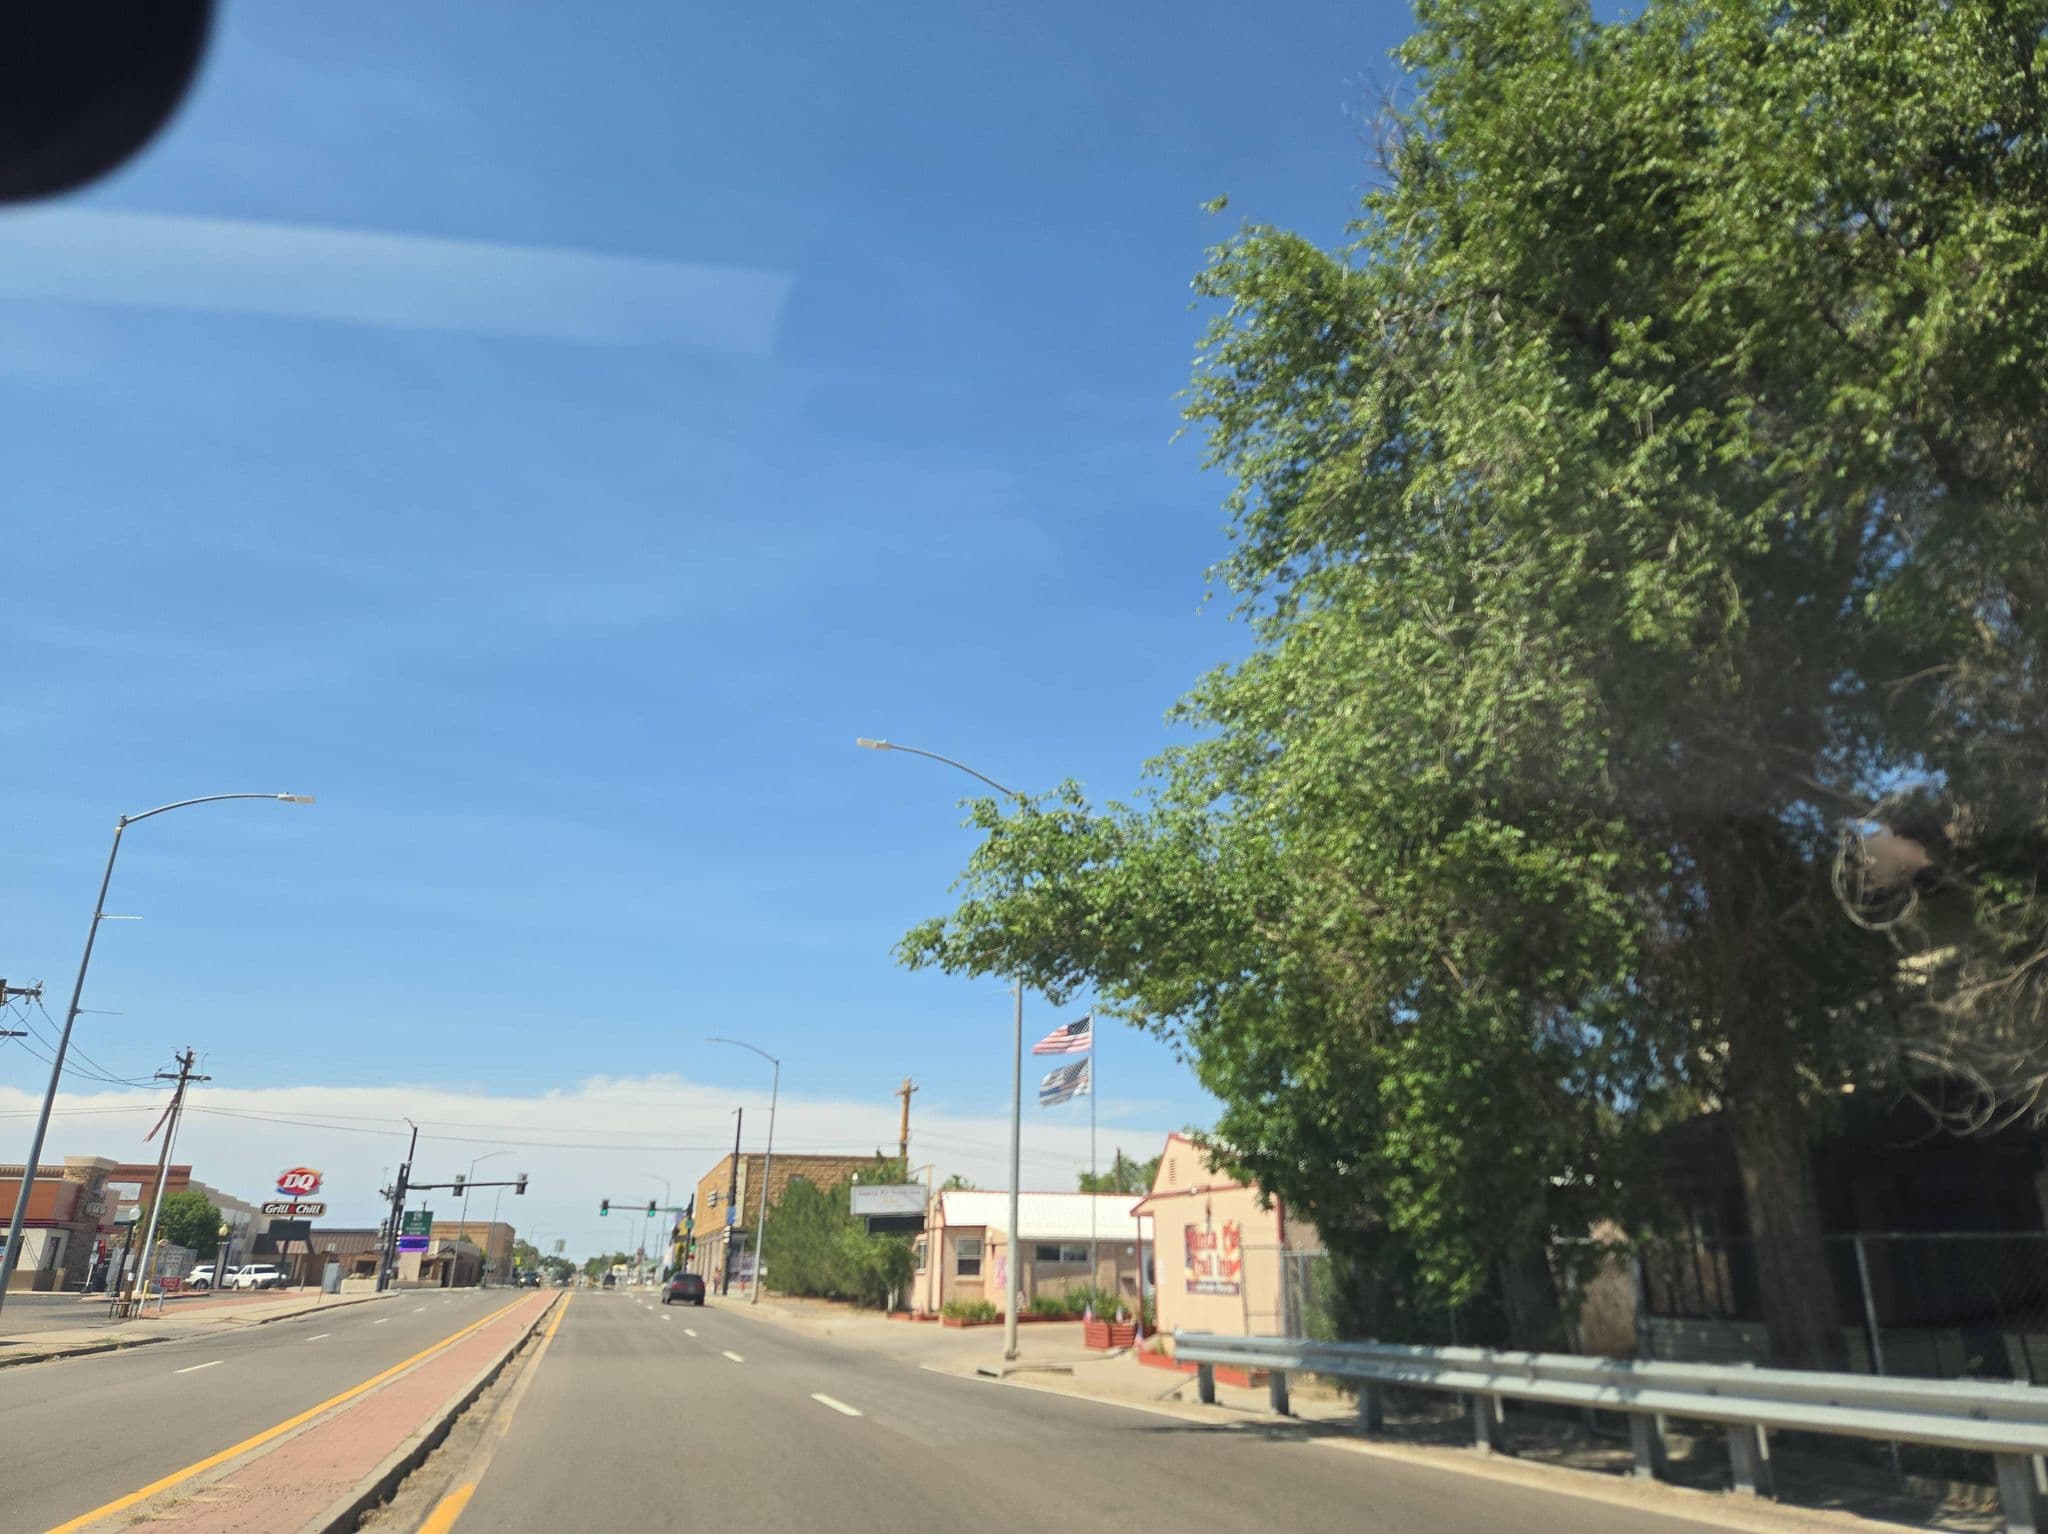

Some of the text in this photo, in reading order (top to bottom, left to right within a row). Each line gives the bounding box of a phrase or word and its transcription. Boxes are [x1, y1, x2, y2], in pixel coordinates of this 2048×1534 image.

[283, 1174, 315, 1191] DQ
[265, 1204, 321, 1214] Grill Chill
